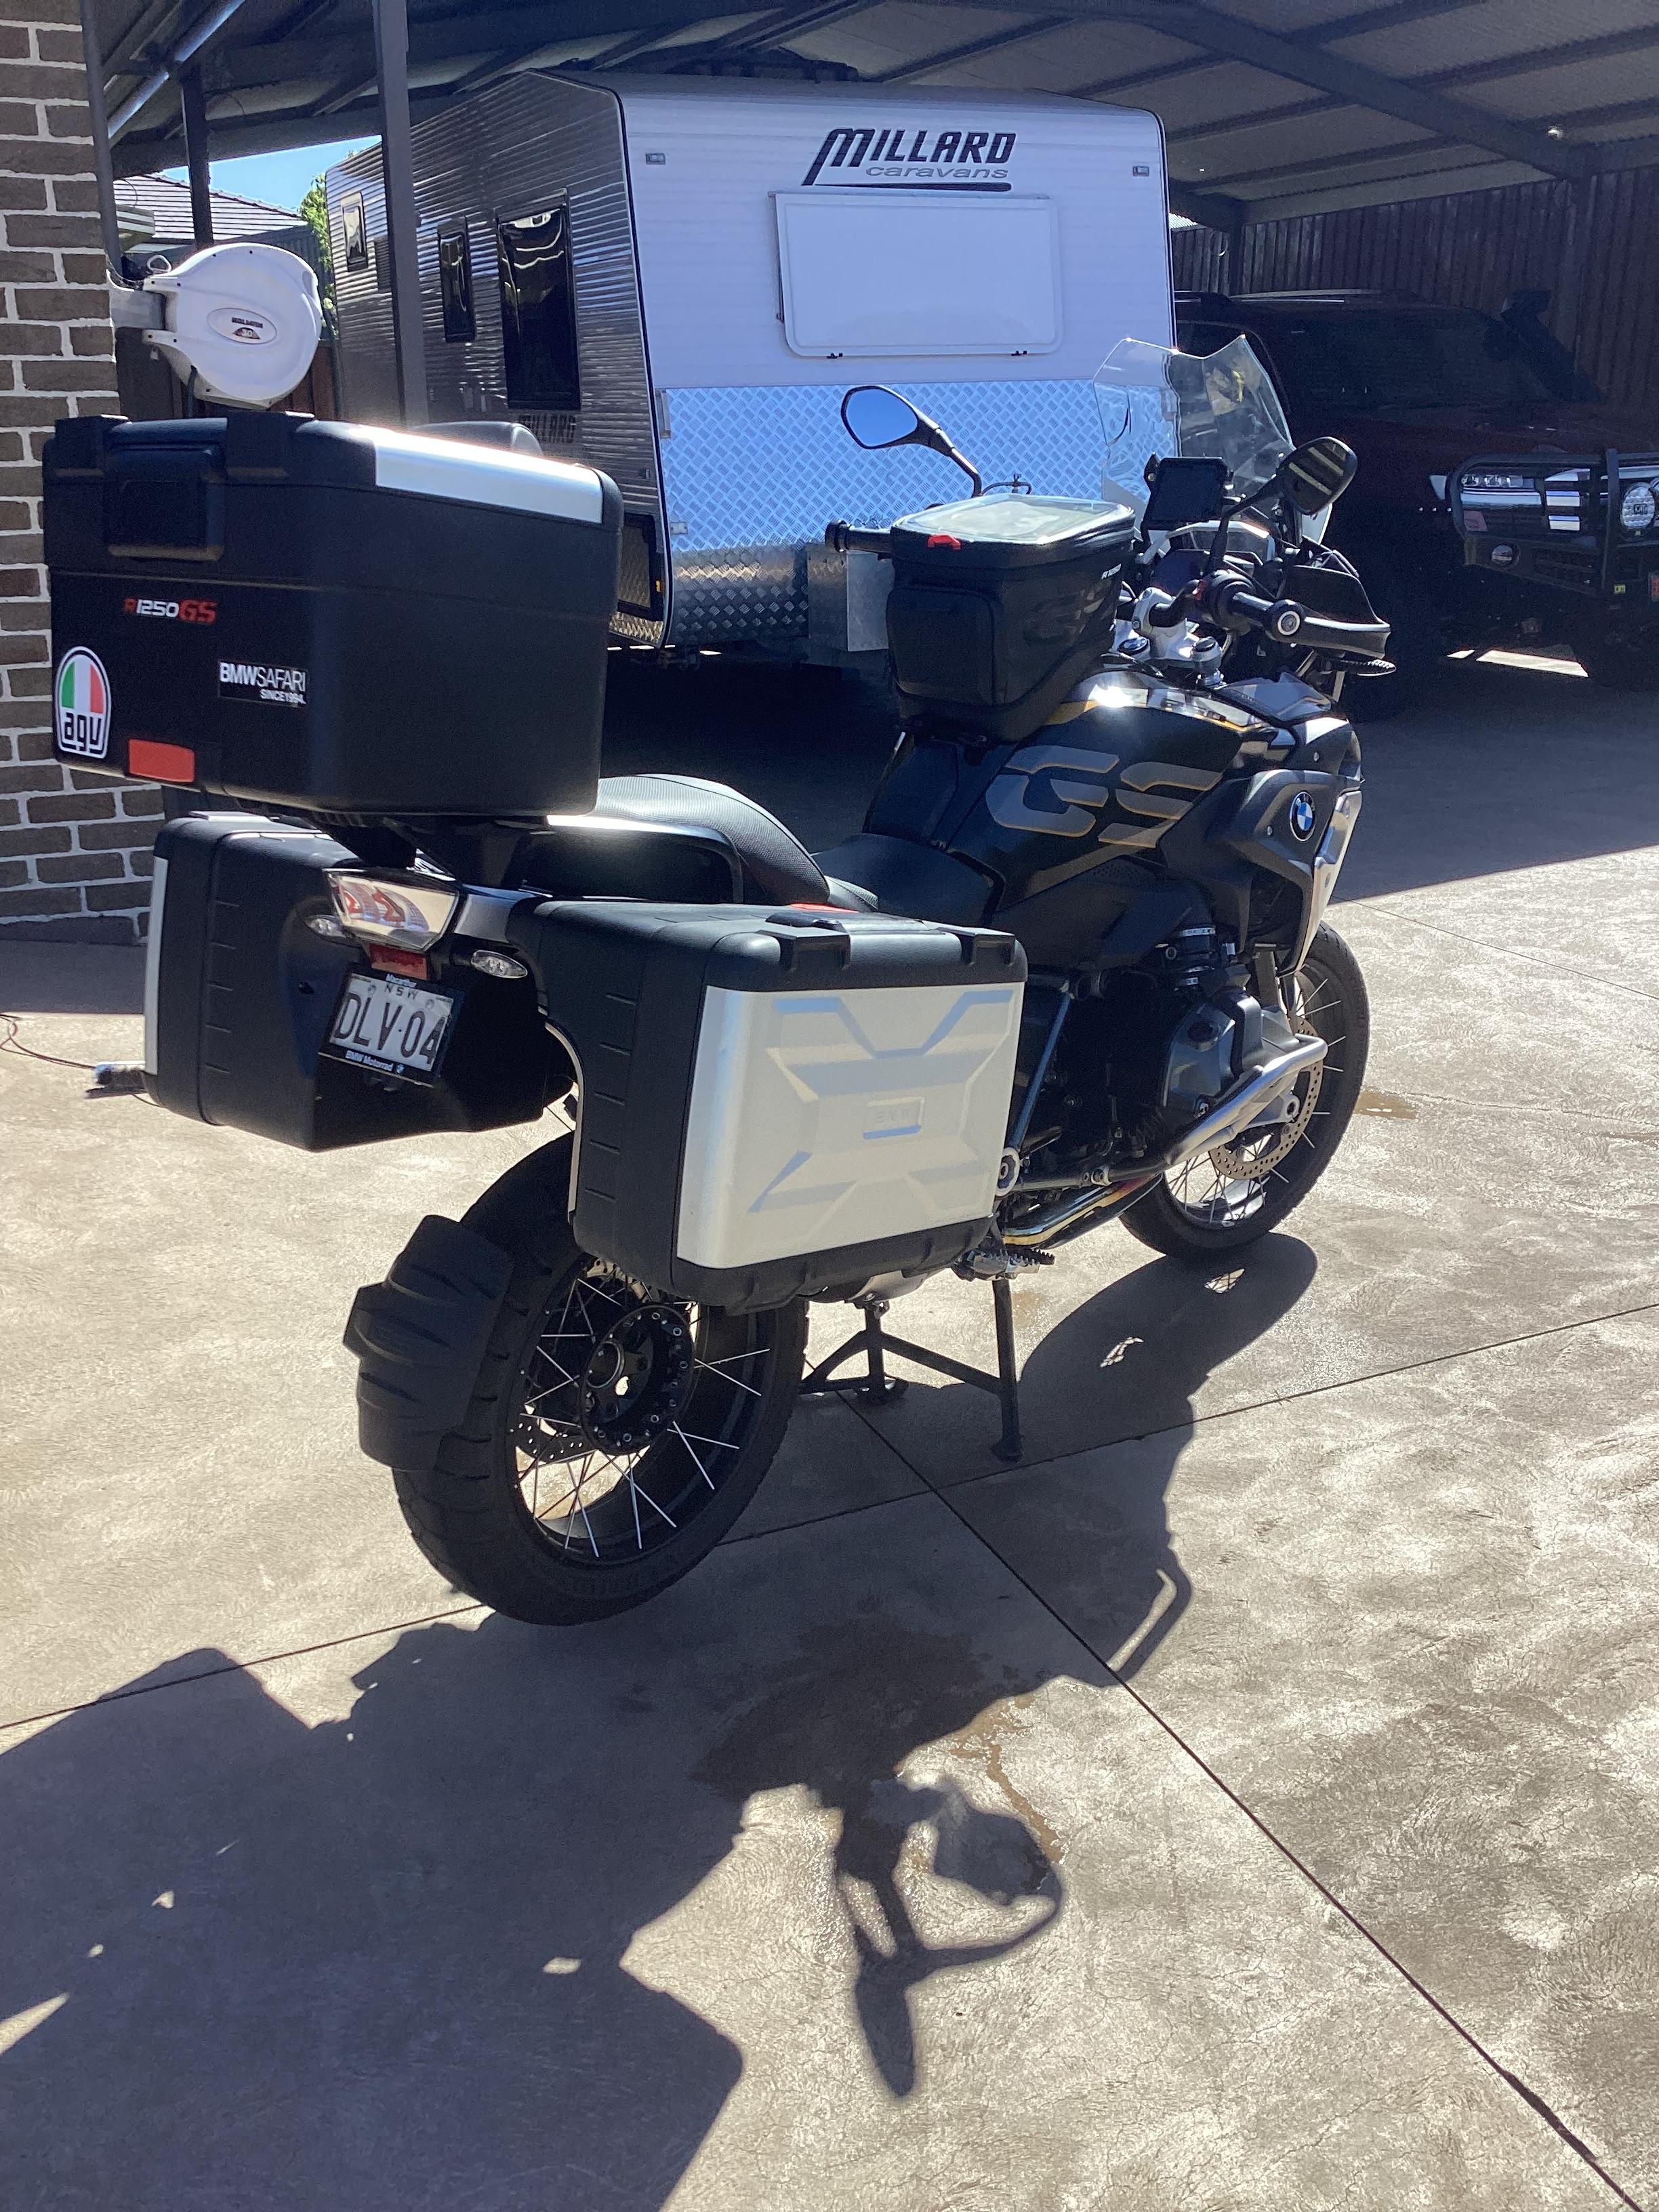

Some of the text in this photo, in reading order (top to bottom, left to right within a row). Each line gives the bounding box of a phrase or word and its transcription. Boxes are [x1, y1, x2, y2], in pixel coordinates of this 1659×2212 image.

[801, 127, 1017, 186] MILLARD
[865, 166, 1008, 179] caravans
[64, 712, 102, 752] agv
